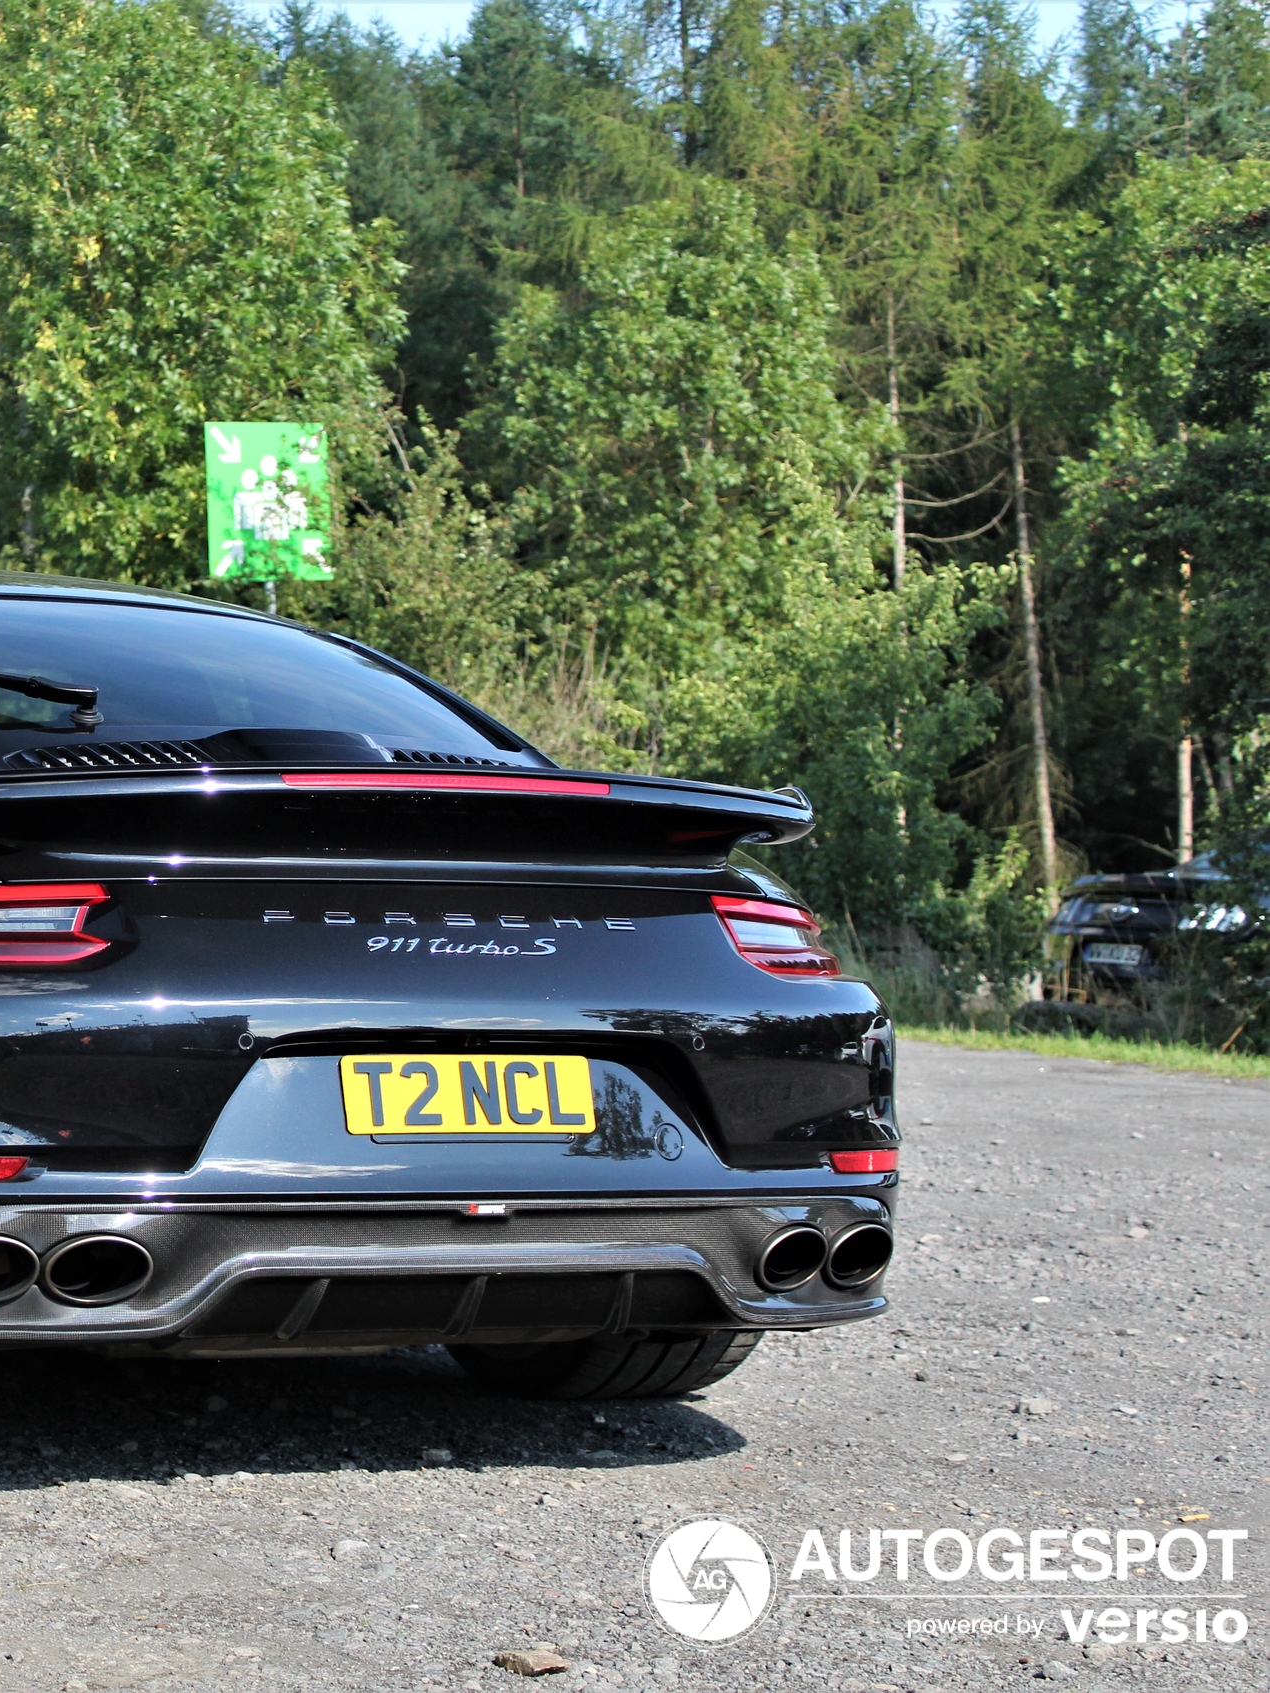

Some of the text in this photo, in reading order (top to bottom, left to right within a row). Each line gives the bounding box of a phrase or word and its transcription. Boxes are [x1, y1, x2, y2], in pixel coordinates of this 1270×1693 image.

[262, 909, 636, 932] PORSCHE
[366, 936, 557, 956] 911 turbo S
[353, 1061, 587, 1127] T2 NCL
